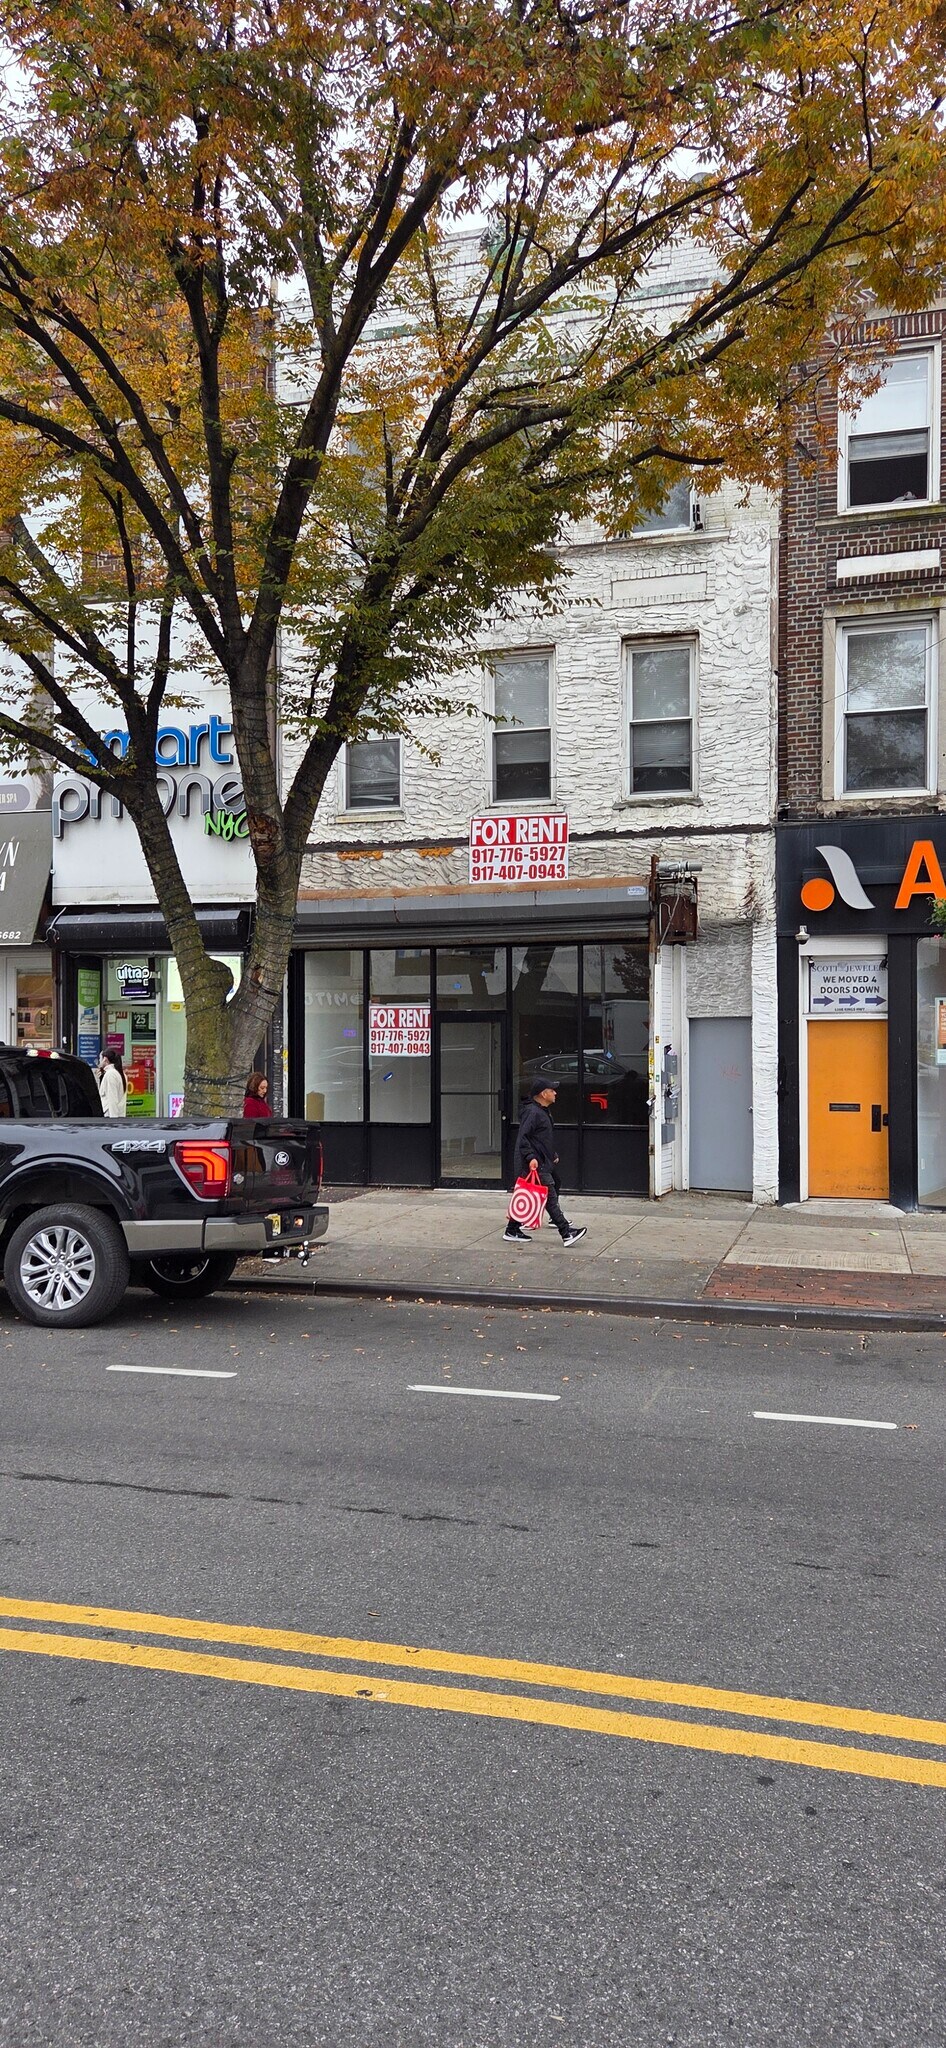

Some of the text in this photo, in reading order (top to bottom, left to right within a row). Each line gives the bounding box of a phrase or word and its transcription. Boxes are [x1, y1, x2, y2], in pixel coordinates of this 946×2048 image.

[205, 809, 250, 841] NYC
[472, 817, 567, 845] FOR RENT
[472, 846, 566, 863] 917-776-5927
[472, 864, 566, 881] 917-407-0943
[820, 986, 880, 994] DOORS DOWN
[371, 1009, 431, 1028] FOR RENT
[371, 1030, 430, 1041] 917-776-5927
[371, 1043, 430, 1054] 917-407-0943
